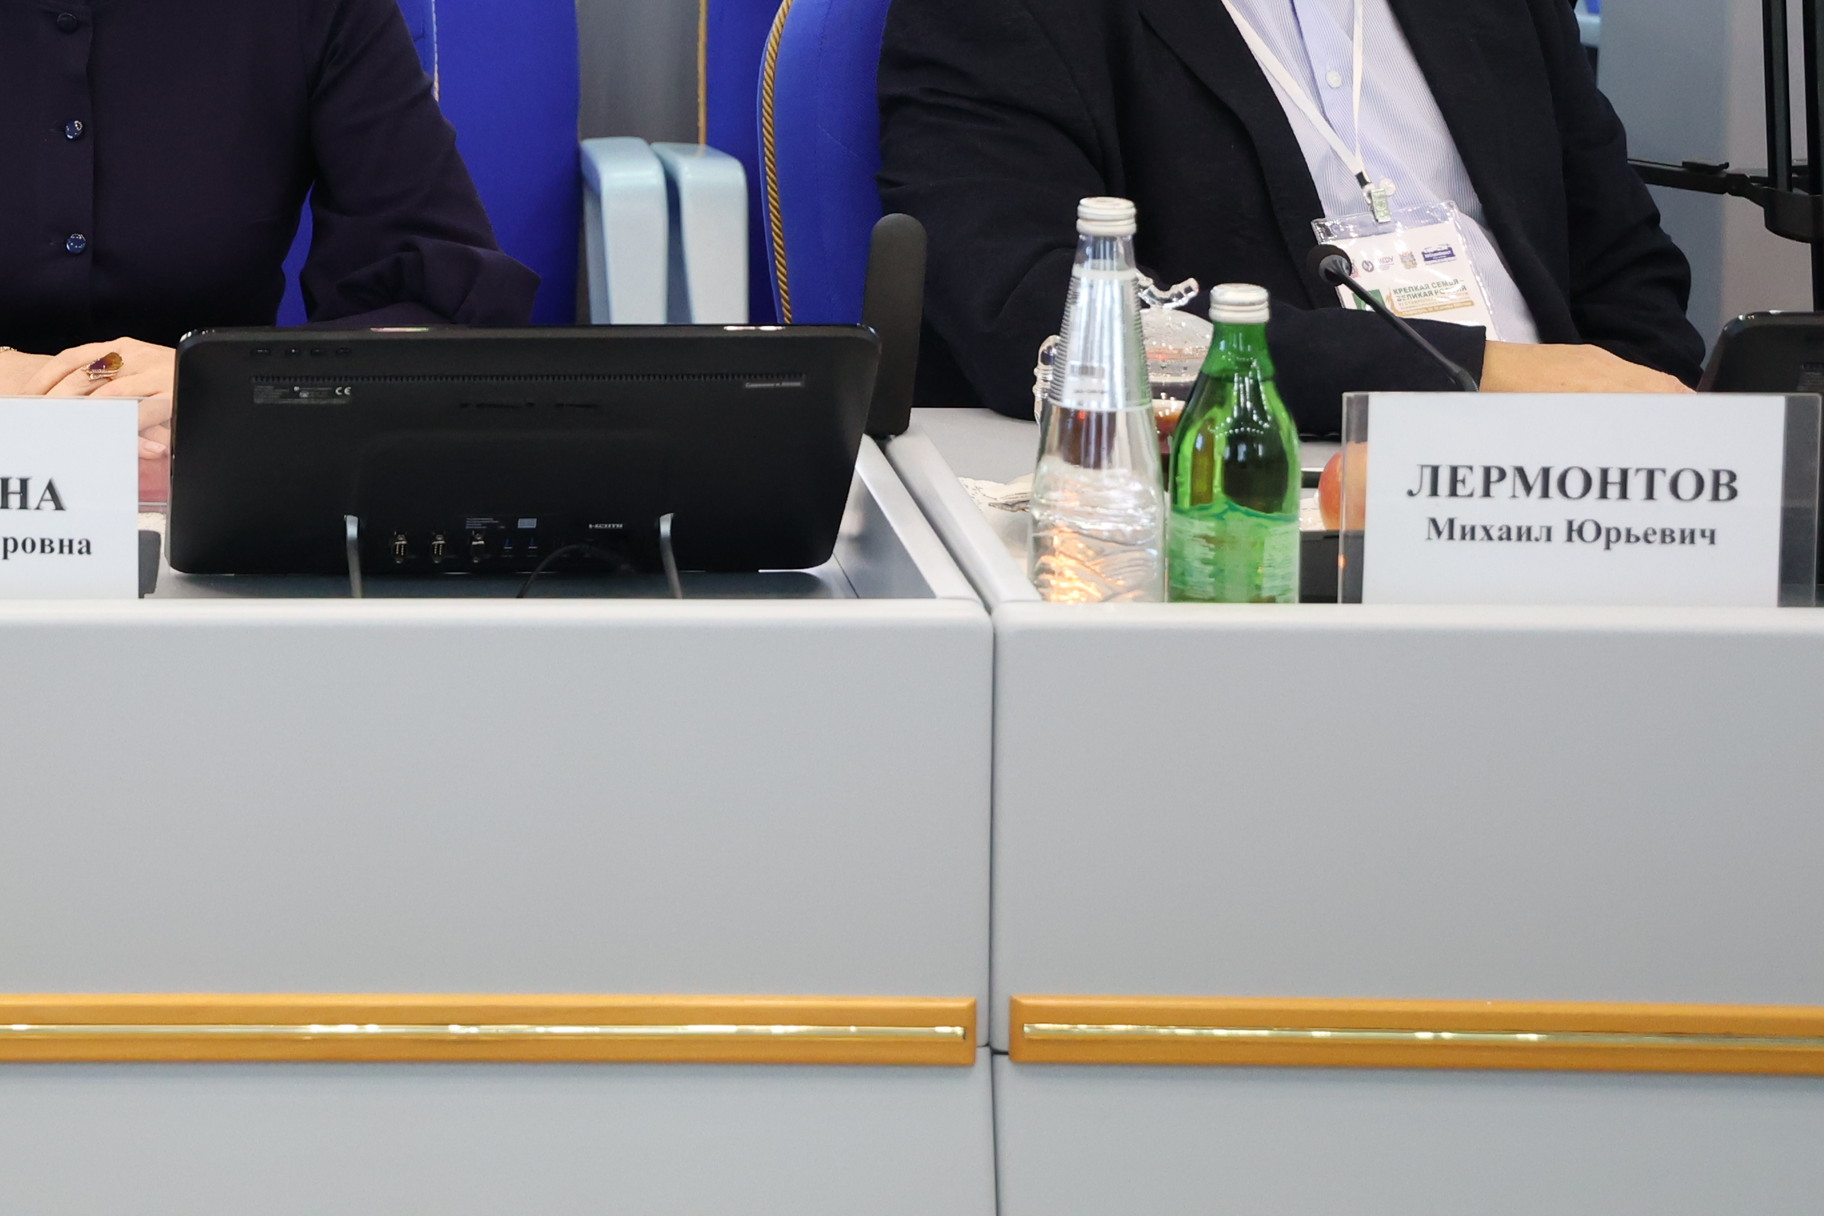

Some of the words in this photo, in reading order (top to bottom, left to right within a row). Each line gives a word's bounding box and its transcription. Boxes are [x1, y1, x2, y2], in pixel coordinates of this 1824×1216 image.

[1392, 284, 1430, 295] КРЕПКАЯ
[1431, 278, 1459, 288] СЕМЬЯ
[1406, 464, 1738, 502] ЛЕРМОНТОВ
[1425, 517, 1553, 542] Михаил
[1564, 519, 1717, 551] Юрьевич
